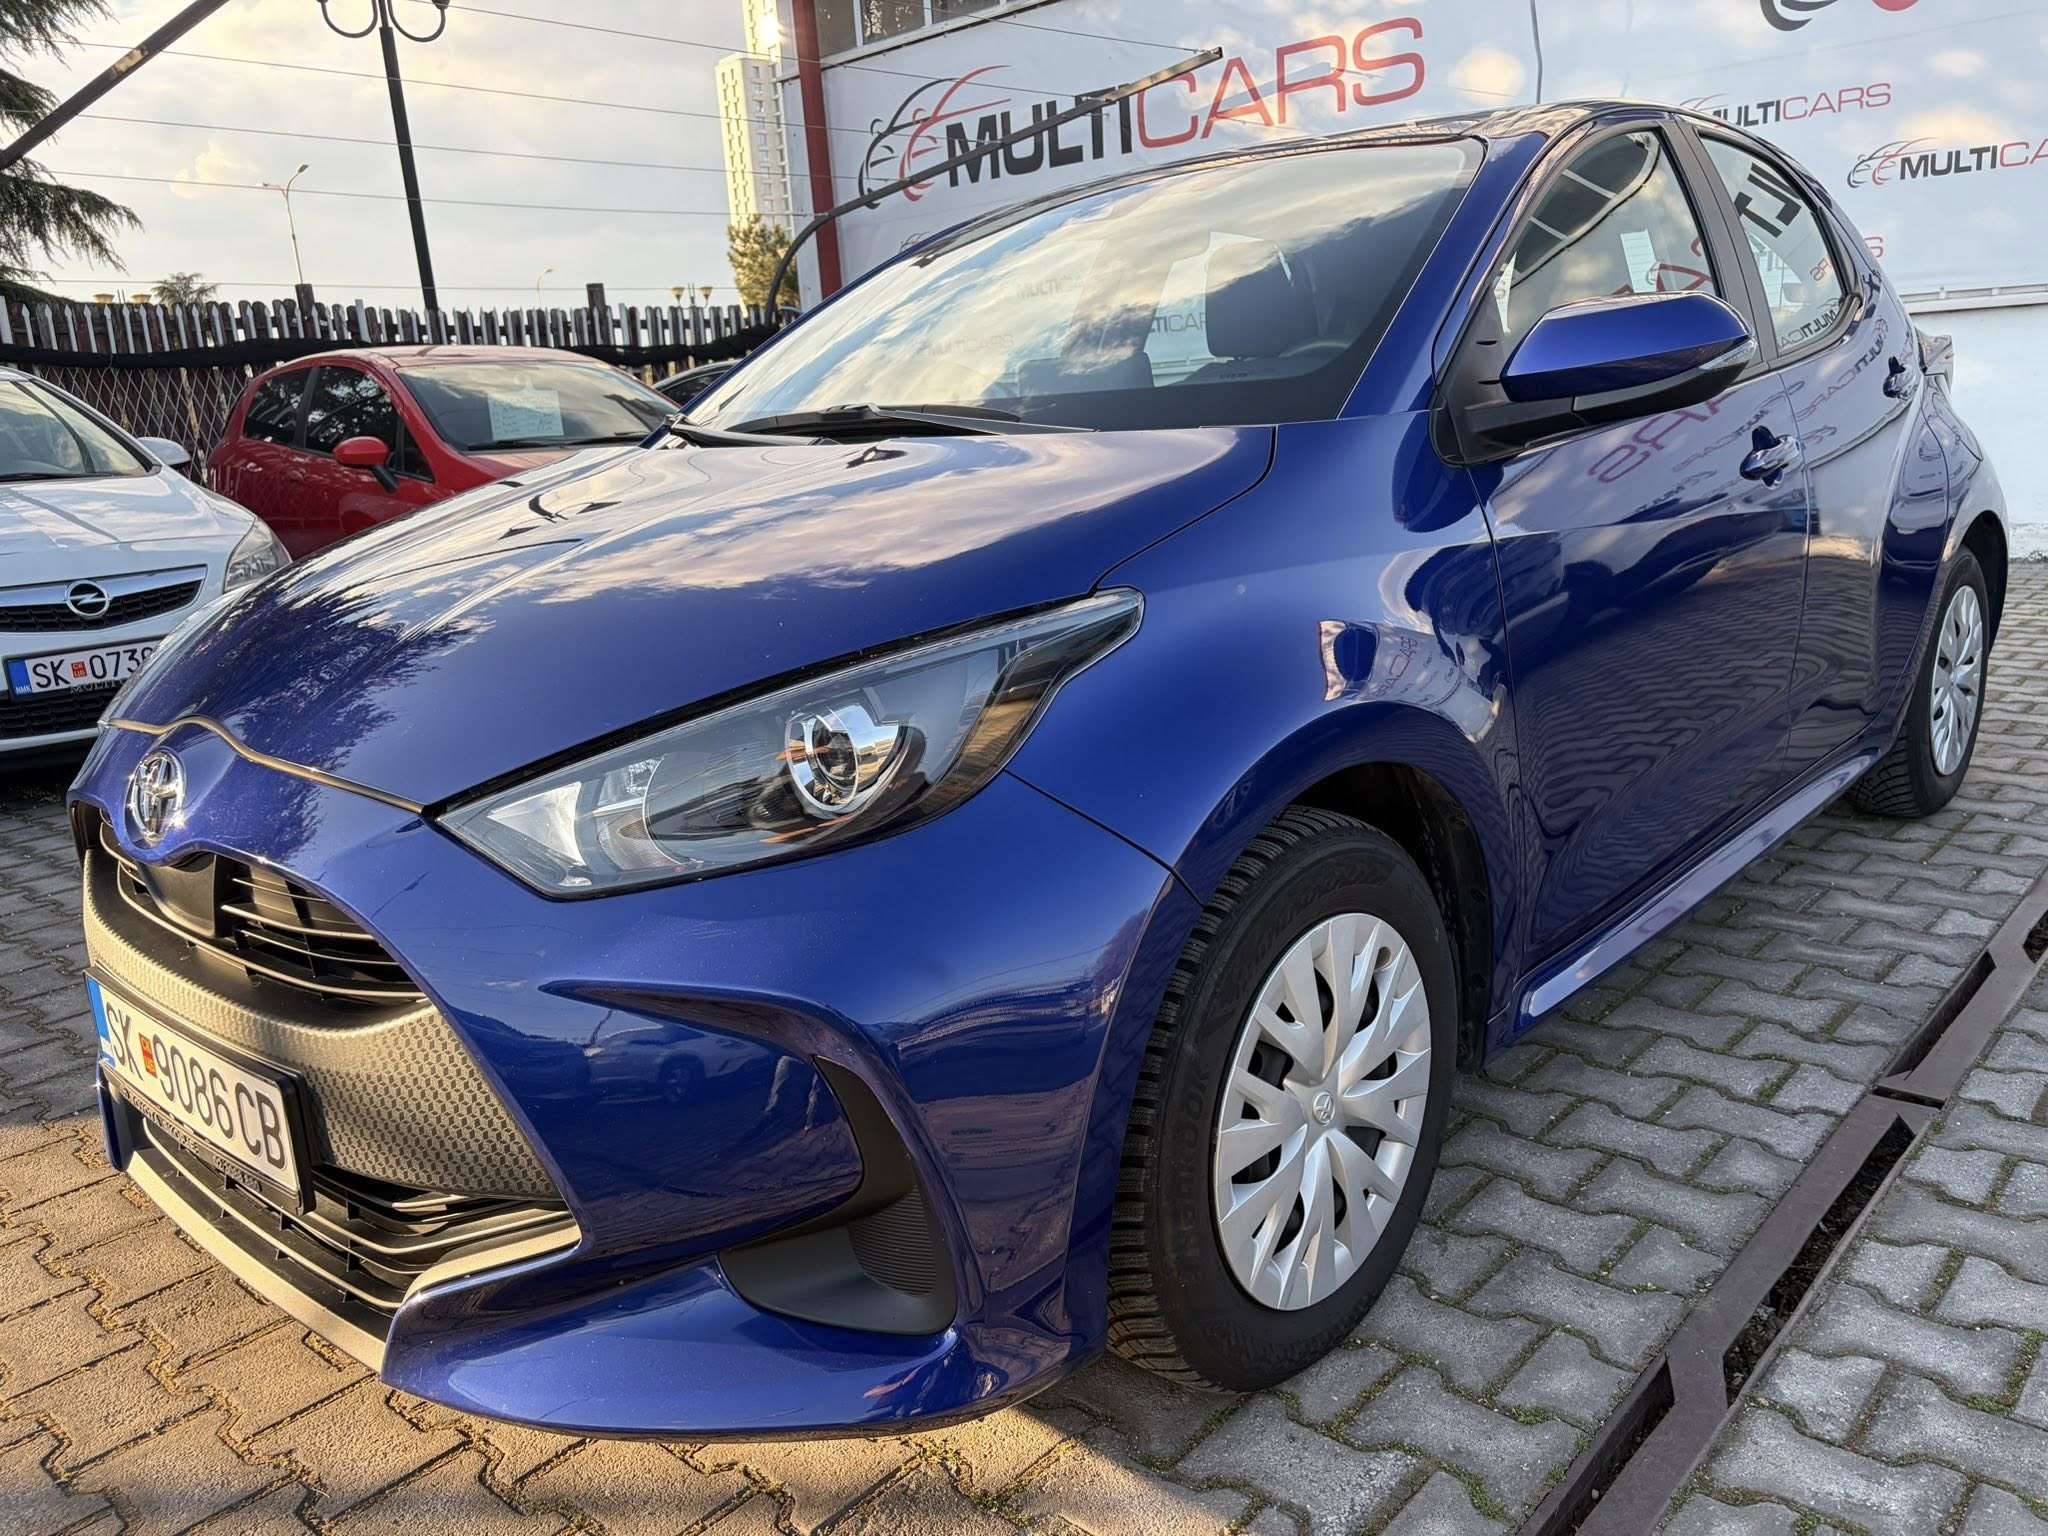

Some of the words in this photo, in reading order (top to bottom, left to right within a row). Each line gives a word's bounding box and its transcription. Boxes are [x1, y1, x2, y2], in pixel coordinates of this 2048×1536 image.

[945, 17, 1426, 187] MULTICARS
[32, 659, 70, 688] SK
[106, 1002, 143, 1080] SK
[152, 1033, 233, 1139] 9086
[235, 1082, 285, 1169] CB
